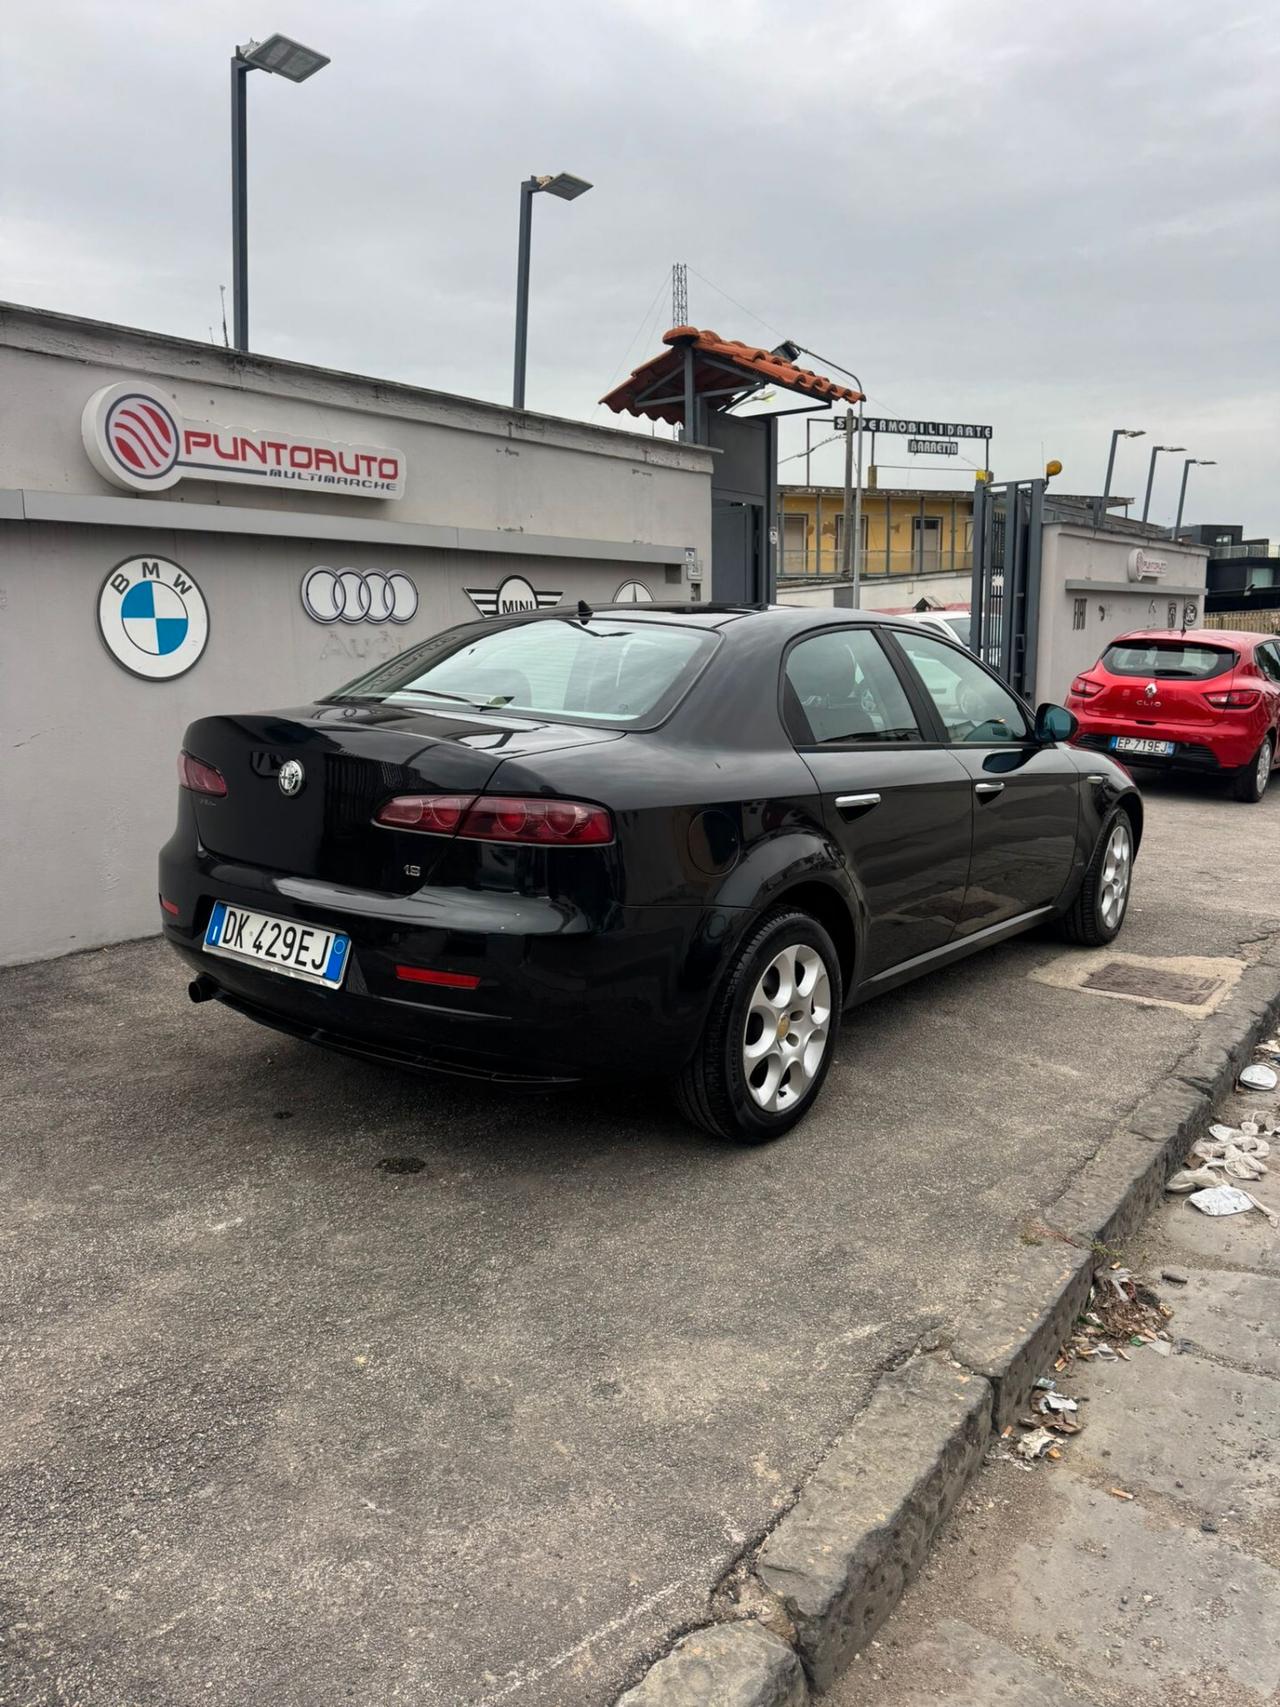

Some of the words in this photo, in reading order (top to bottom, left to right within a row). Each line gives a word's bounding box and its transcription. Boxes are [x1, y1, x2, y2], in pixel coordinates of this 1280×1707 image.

[184, 430, 399, 480] PUNTOAUTO
[268, 468, 398, 491] MULTIMARCHE
[110, 561, 193, 596] BMW
[502, 600, 533, 613] MINI
[1136, 699, 1162, 707] CLIO
[1117, 736, 1131, 749] EP
[1133, 740, 1168, 753] 719EJ
[222, 910, 251, 949] DK
[252, 920, 331, 970] 429EJ
